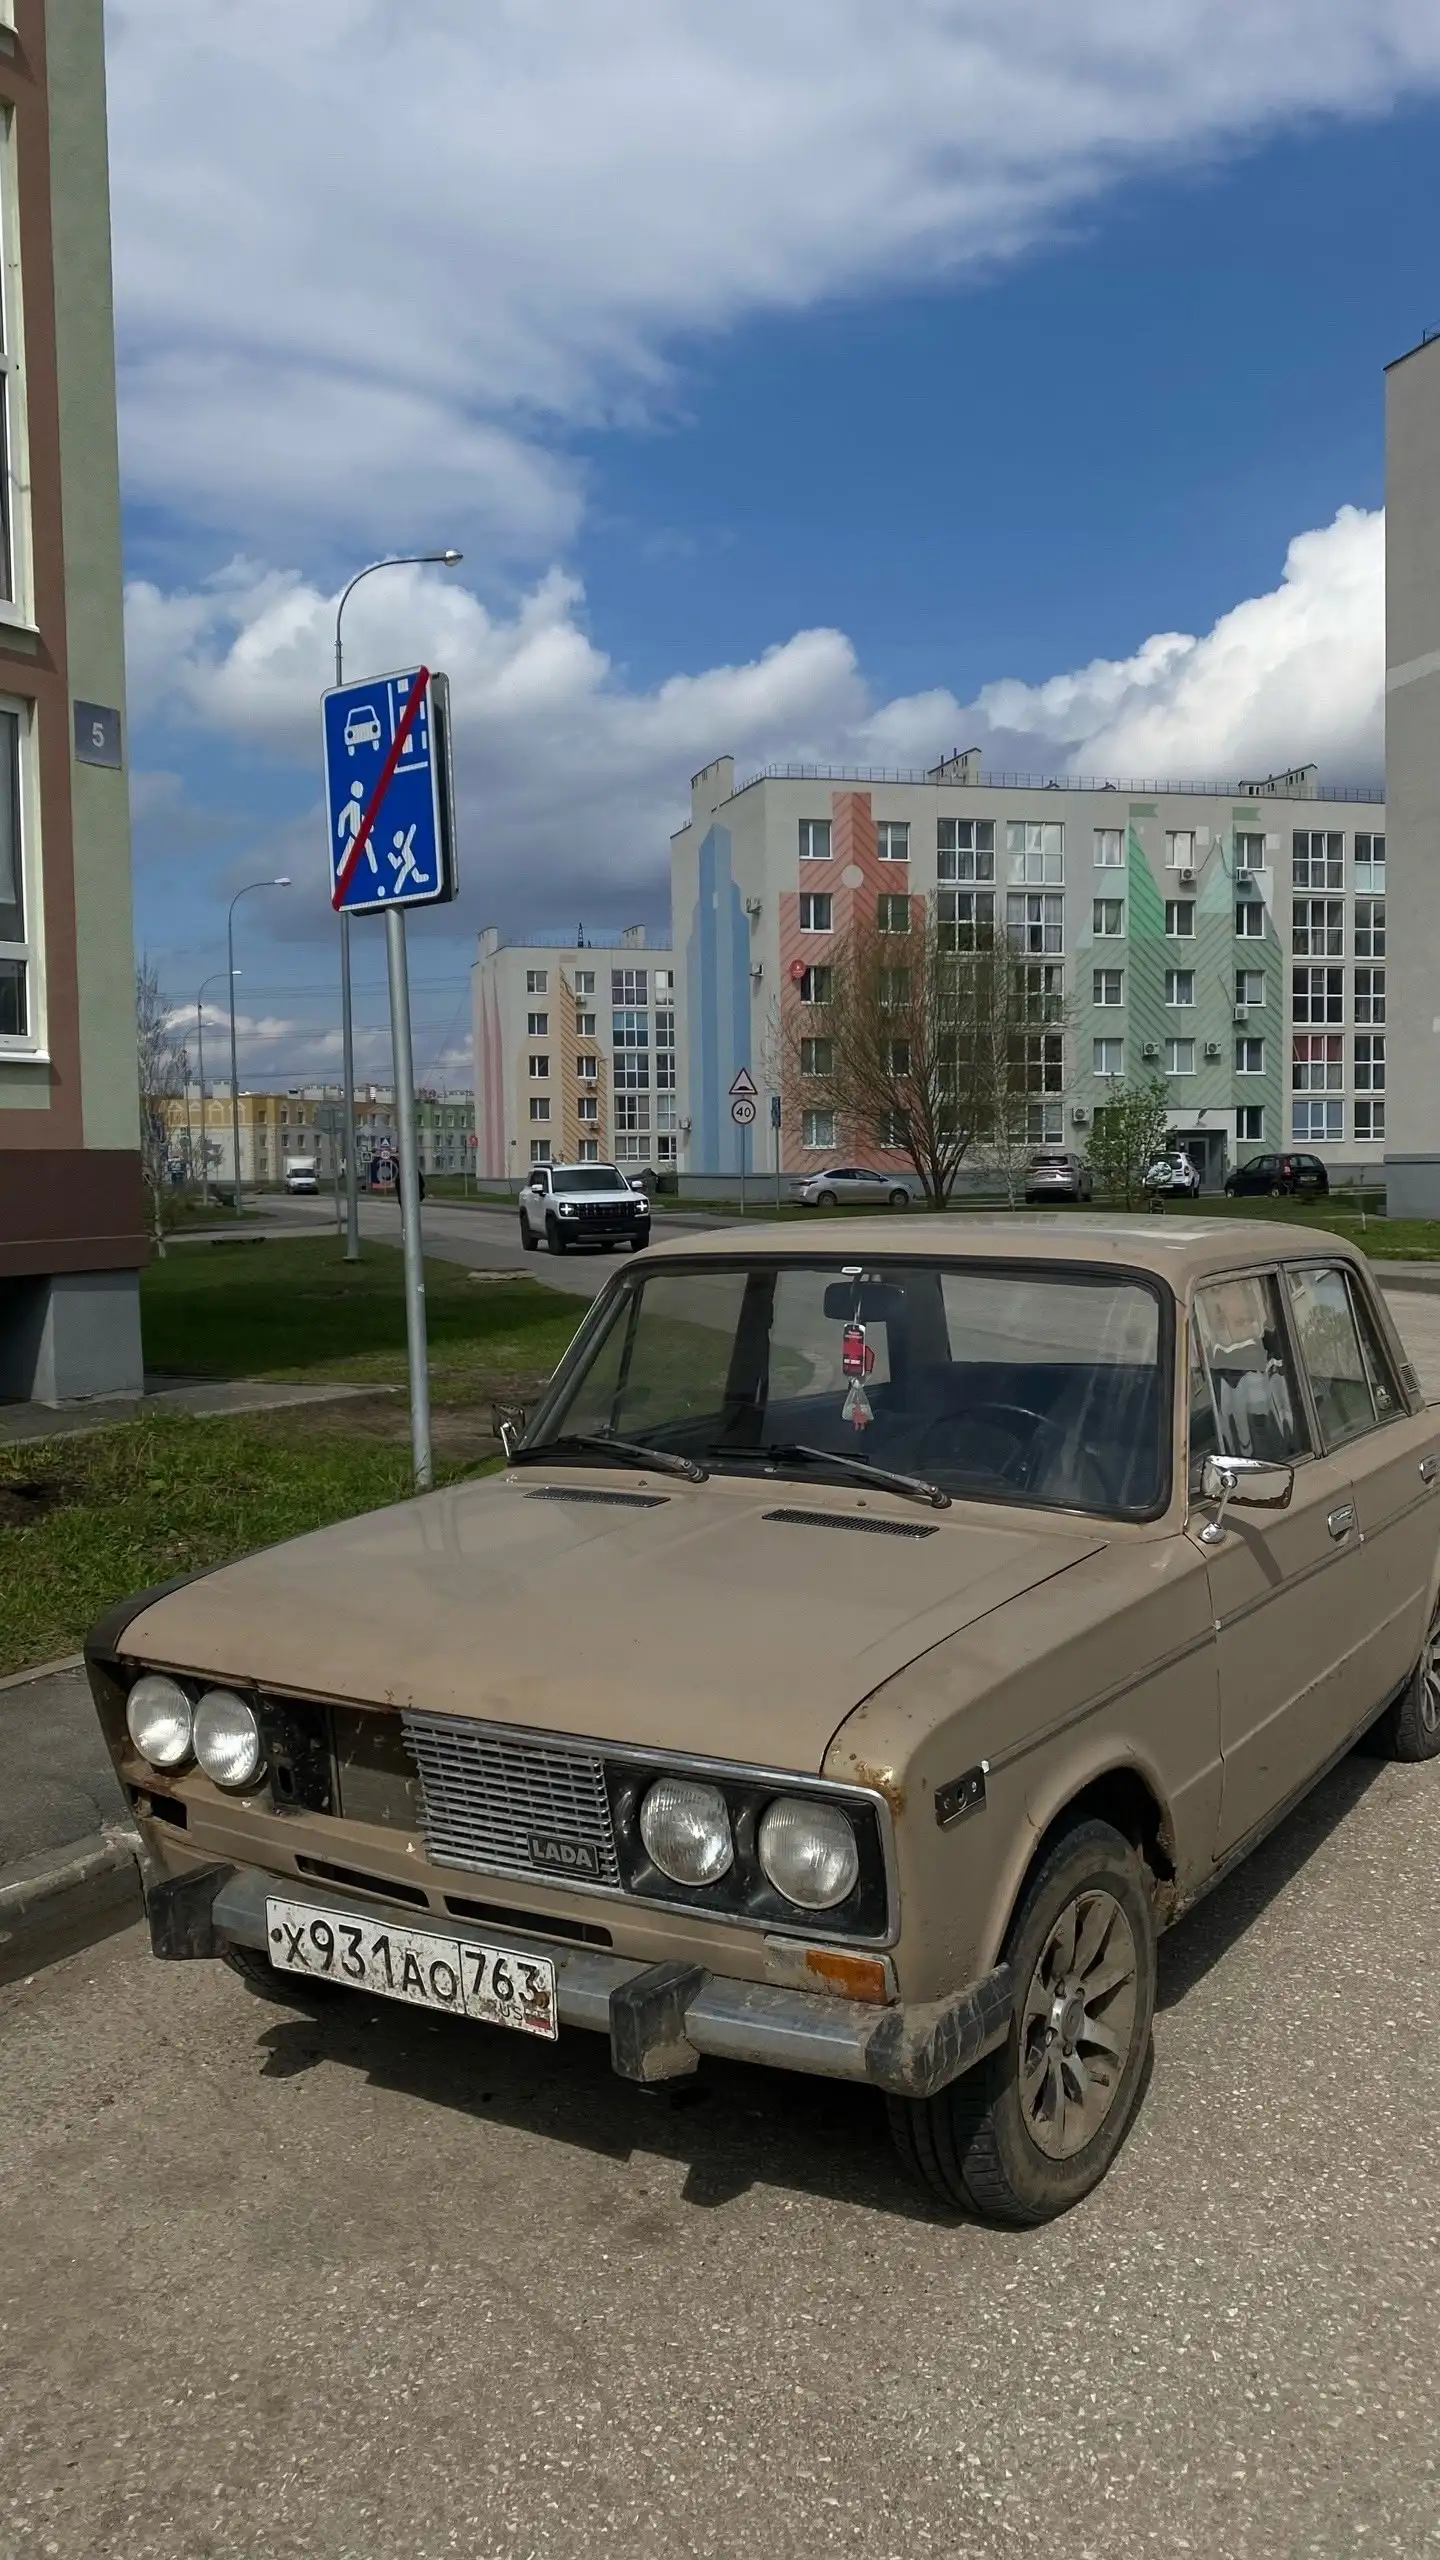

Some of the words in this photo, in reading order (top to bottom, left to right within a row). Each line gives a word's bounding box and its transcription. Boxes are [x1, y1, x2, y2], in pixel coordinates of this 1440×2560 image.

[92, 721, 105, 748] 5
[736, 1107, 751, 1118] 40
[532, 1839, 593, 1868] LADA
[281, 1919, 458, 2001] Х931АО
[465, 1950, 546, 2006] 763
